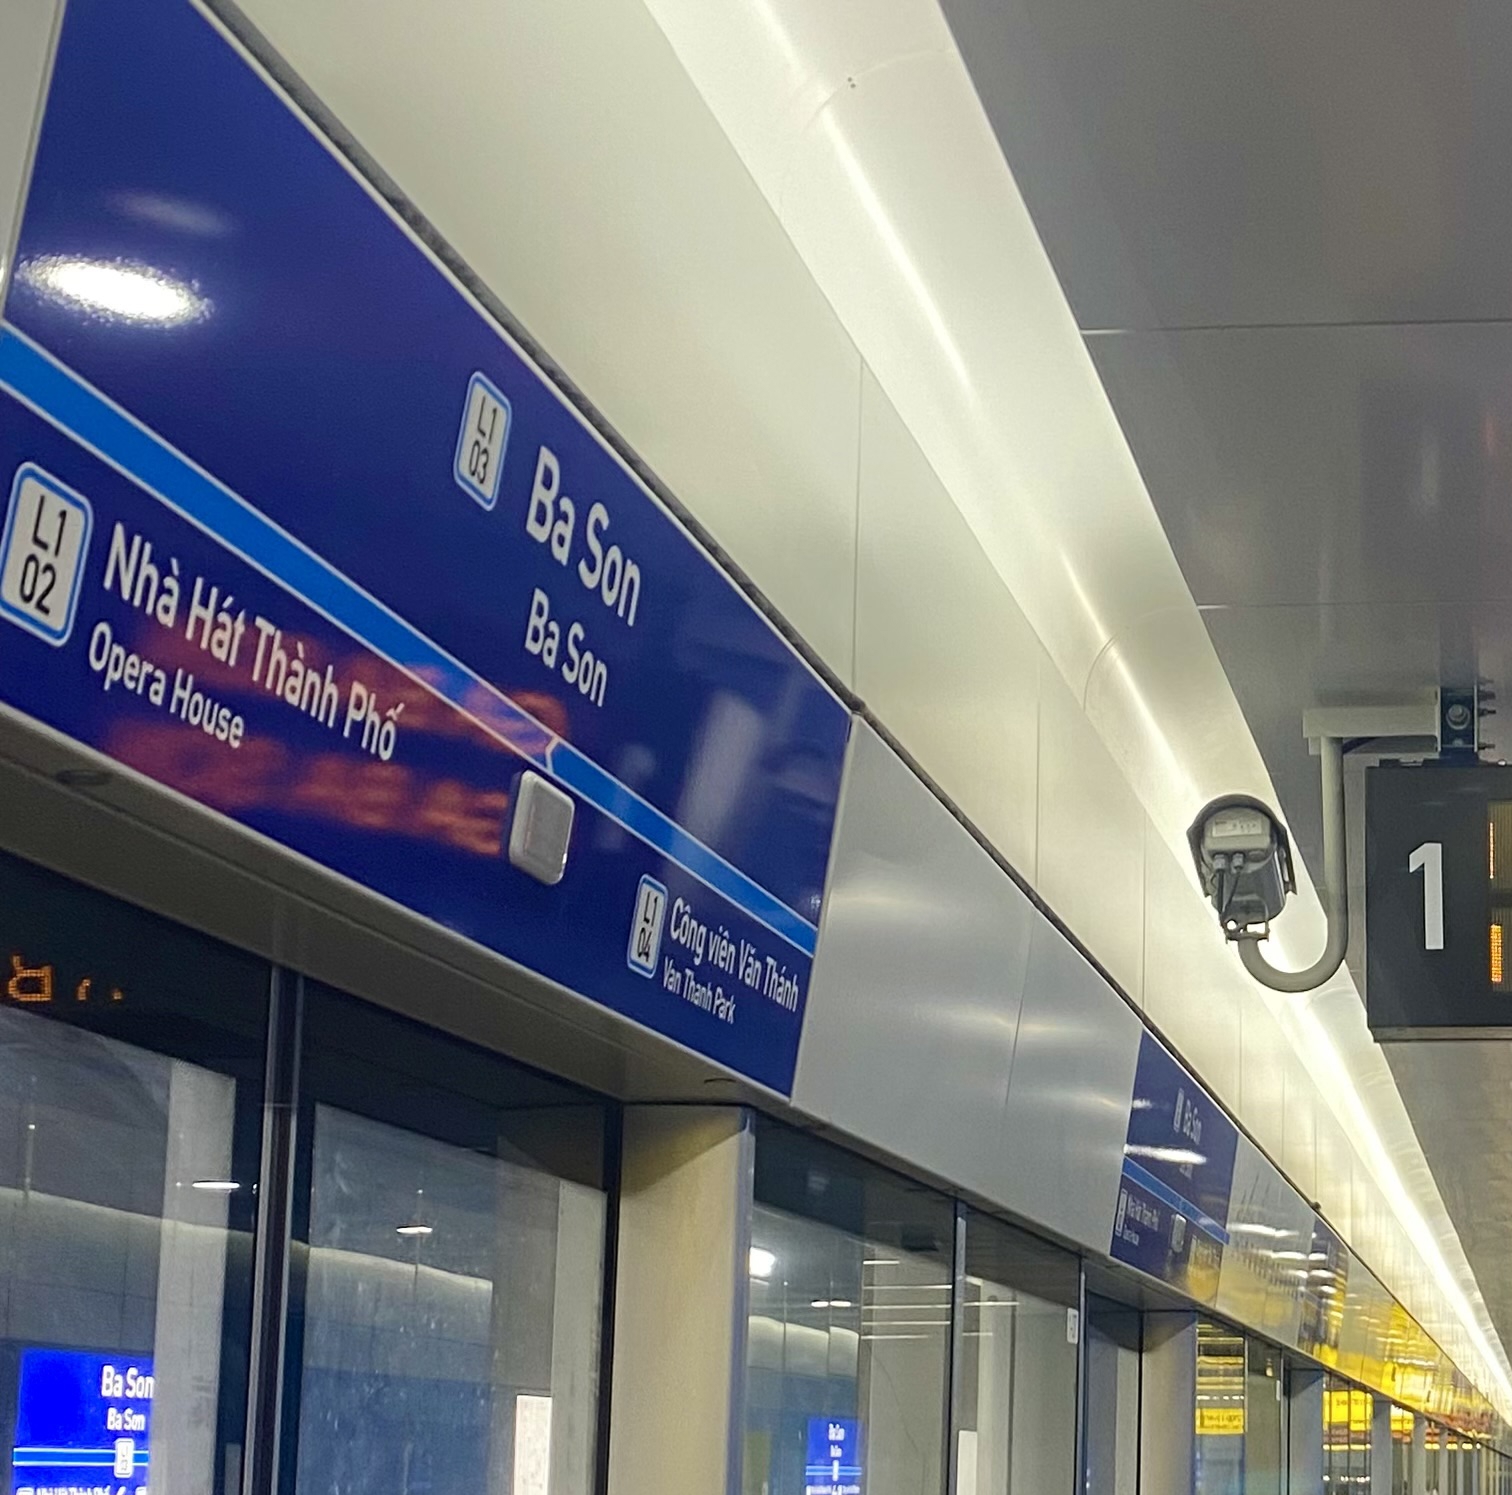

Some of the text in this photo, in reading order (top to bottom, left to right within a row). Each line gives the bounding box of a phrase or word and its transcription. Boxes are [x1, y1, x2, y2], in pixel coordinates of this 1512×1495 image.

[469, 440, 490, 485] 03
[32, 495, 67, 556] L1
[525, 445, 641, 627] Ba Son
[19, 553, 57, 616] 02
[88, 621, 245, 749] Opera House
[103, 521, 405, 761] Nhà Hát Thành Phố
[524, 587, 608, 708] Ba Son
[1407, 840, 1444, 951] 1
[663, 955, 736, 1025] Van Thanh Park
[670, 897, 799, 1013] Công viên Văn Thánh
[101, 1364, 154, 1399] Ba Son
[106, 1406, 146, 1431] Ba Son
